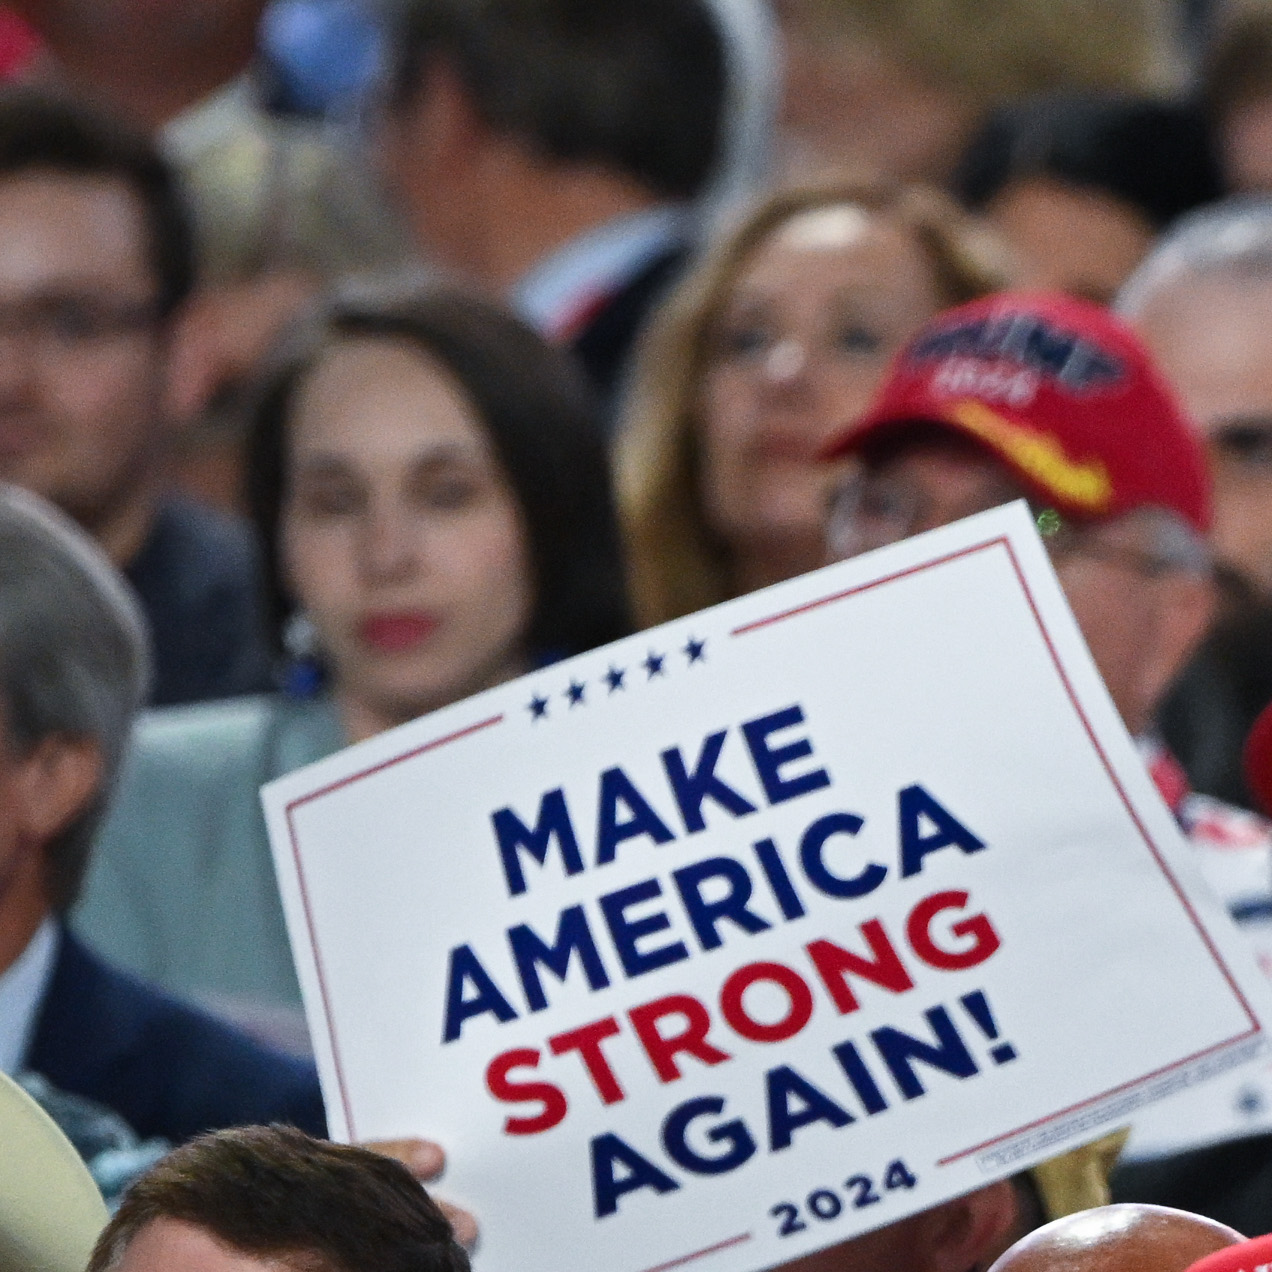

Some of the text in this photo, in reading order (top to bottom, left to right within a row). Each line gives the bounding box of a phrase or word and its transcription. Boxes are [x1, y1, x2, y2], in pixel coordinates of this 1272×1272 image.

[441, 783, 988, 1045] AMERICA
[490, 704, 832, 896] MAKE
[484, 888, 1002, 1136] STRONG
[588, 988, 1018, 1219] AGAIN!
[769, 1159, 918, 1238] 2024
